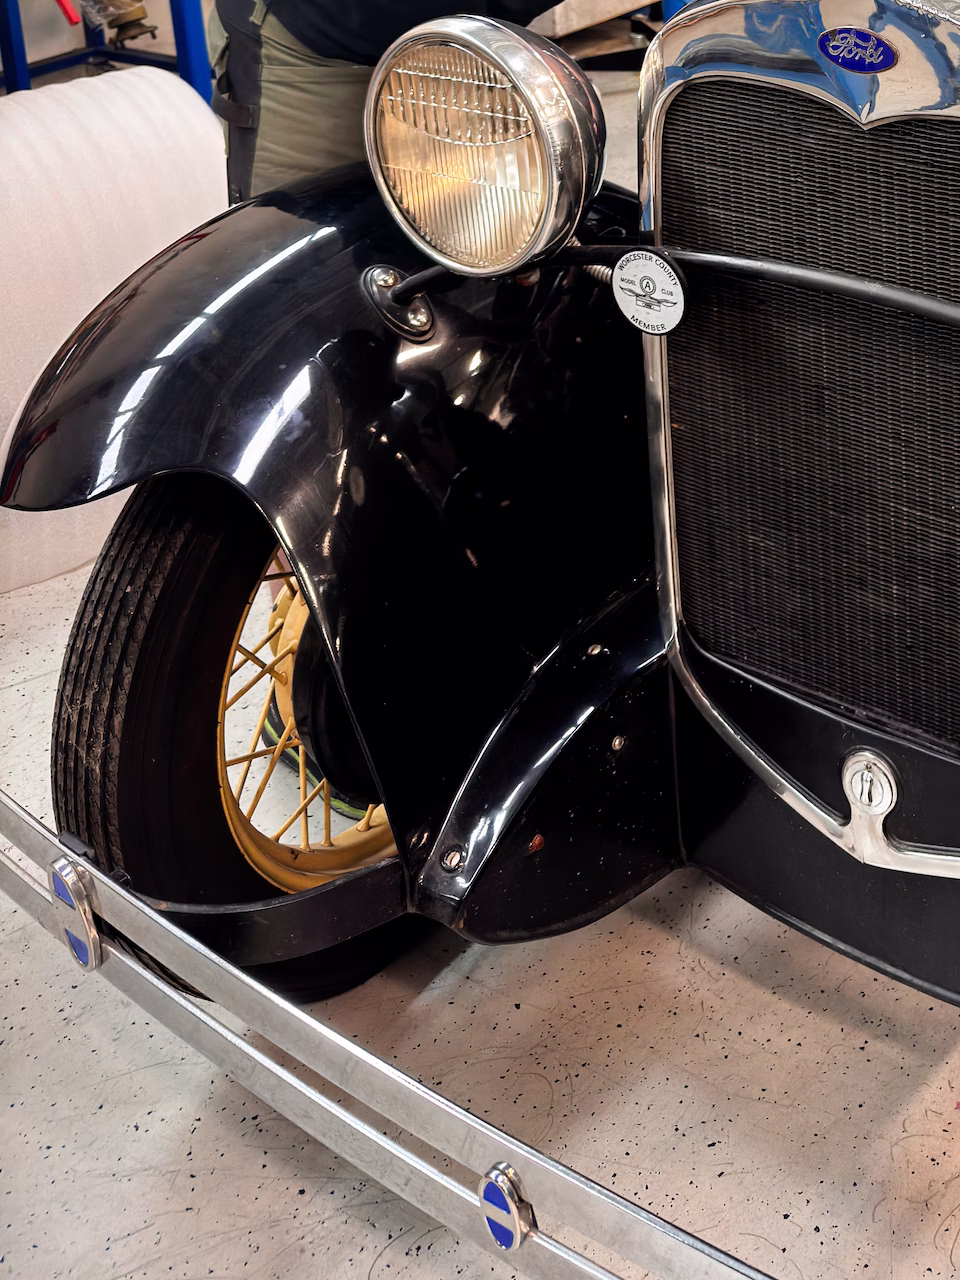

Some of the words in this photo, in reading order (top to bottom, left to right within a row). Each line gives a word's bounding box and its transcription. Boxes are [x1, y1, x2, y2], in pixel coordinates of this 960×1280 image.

[825, 31, 884, 64] Ford
[617, 253, 653, 271] WORCESTER
[654, 258, 679, 287] COUNTY
[620, 277, 637, 286] MODEL
[644, 281, 651, 291] A
[660, 288, 674, 297] CLUB
[630, 314, 667, 332] MEMBER
